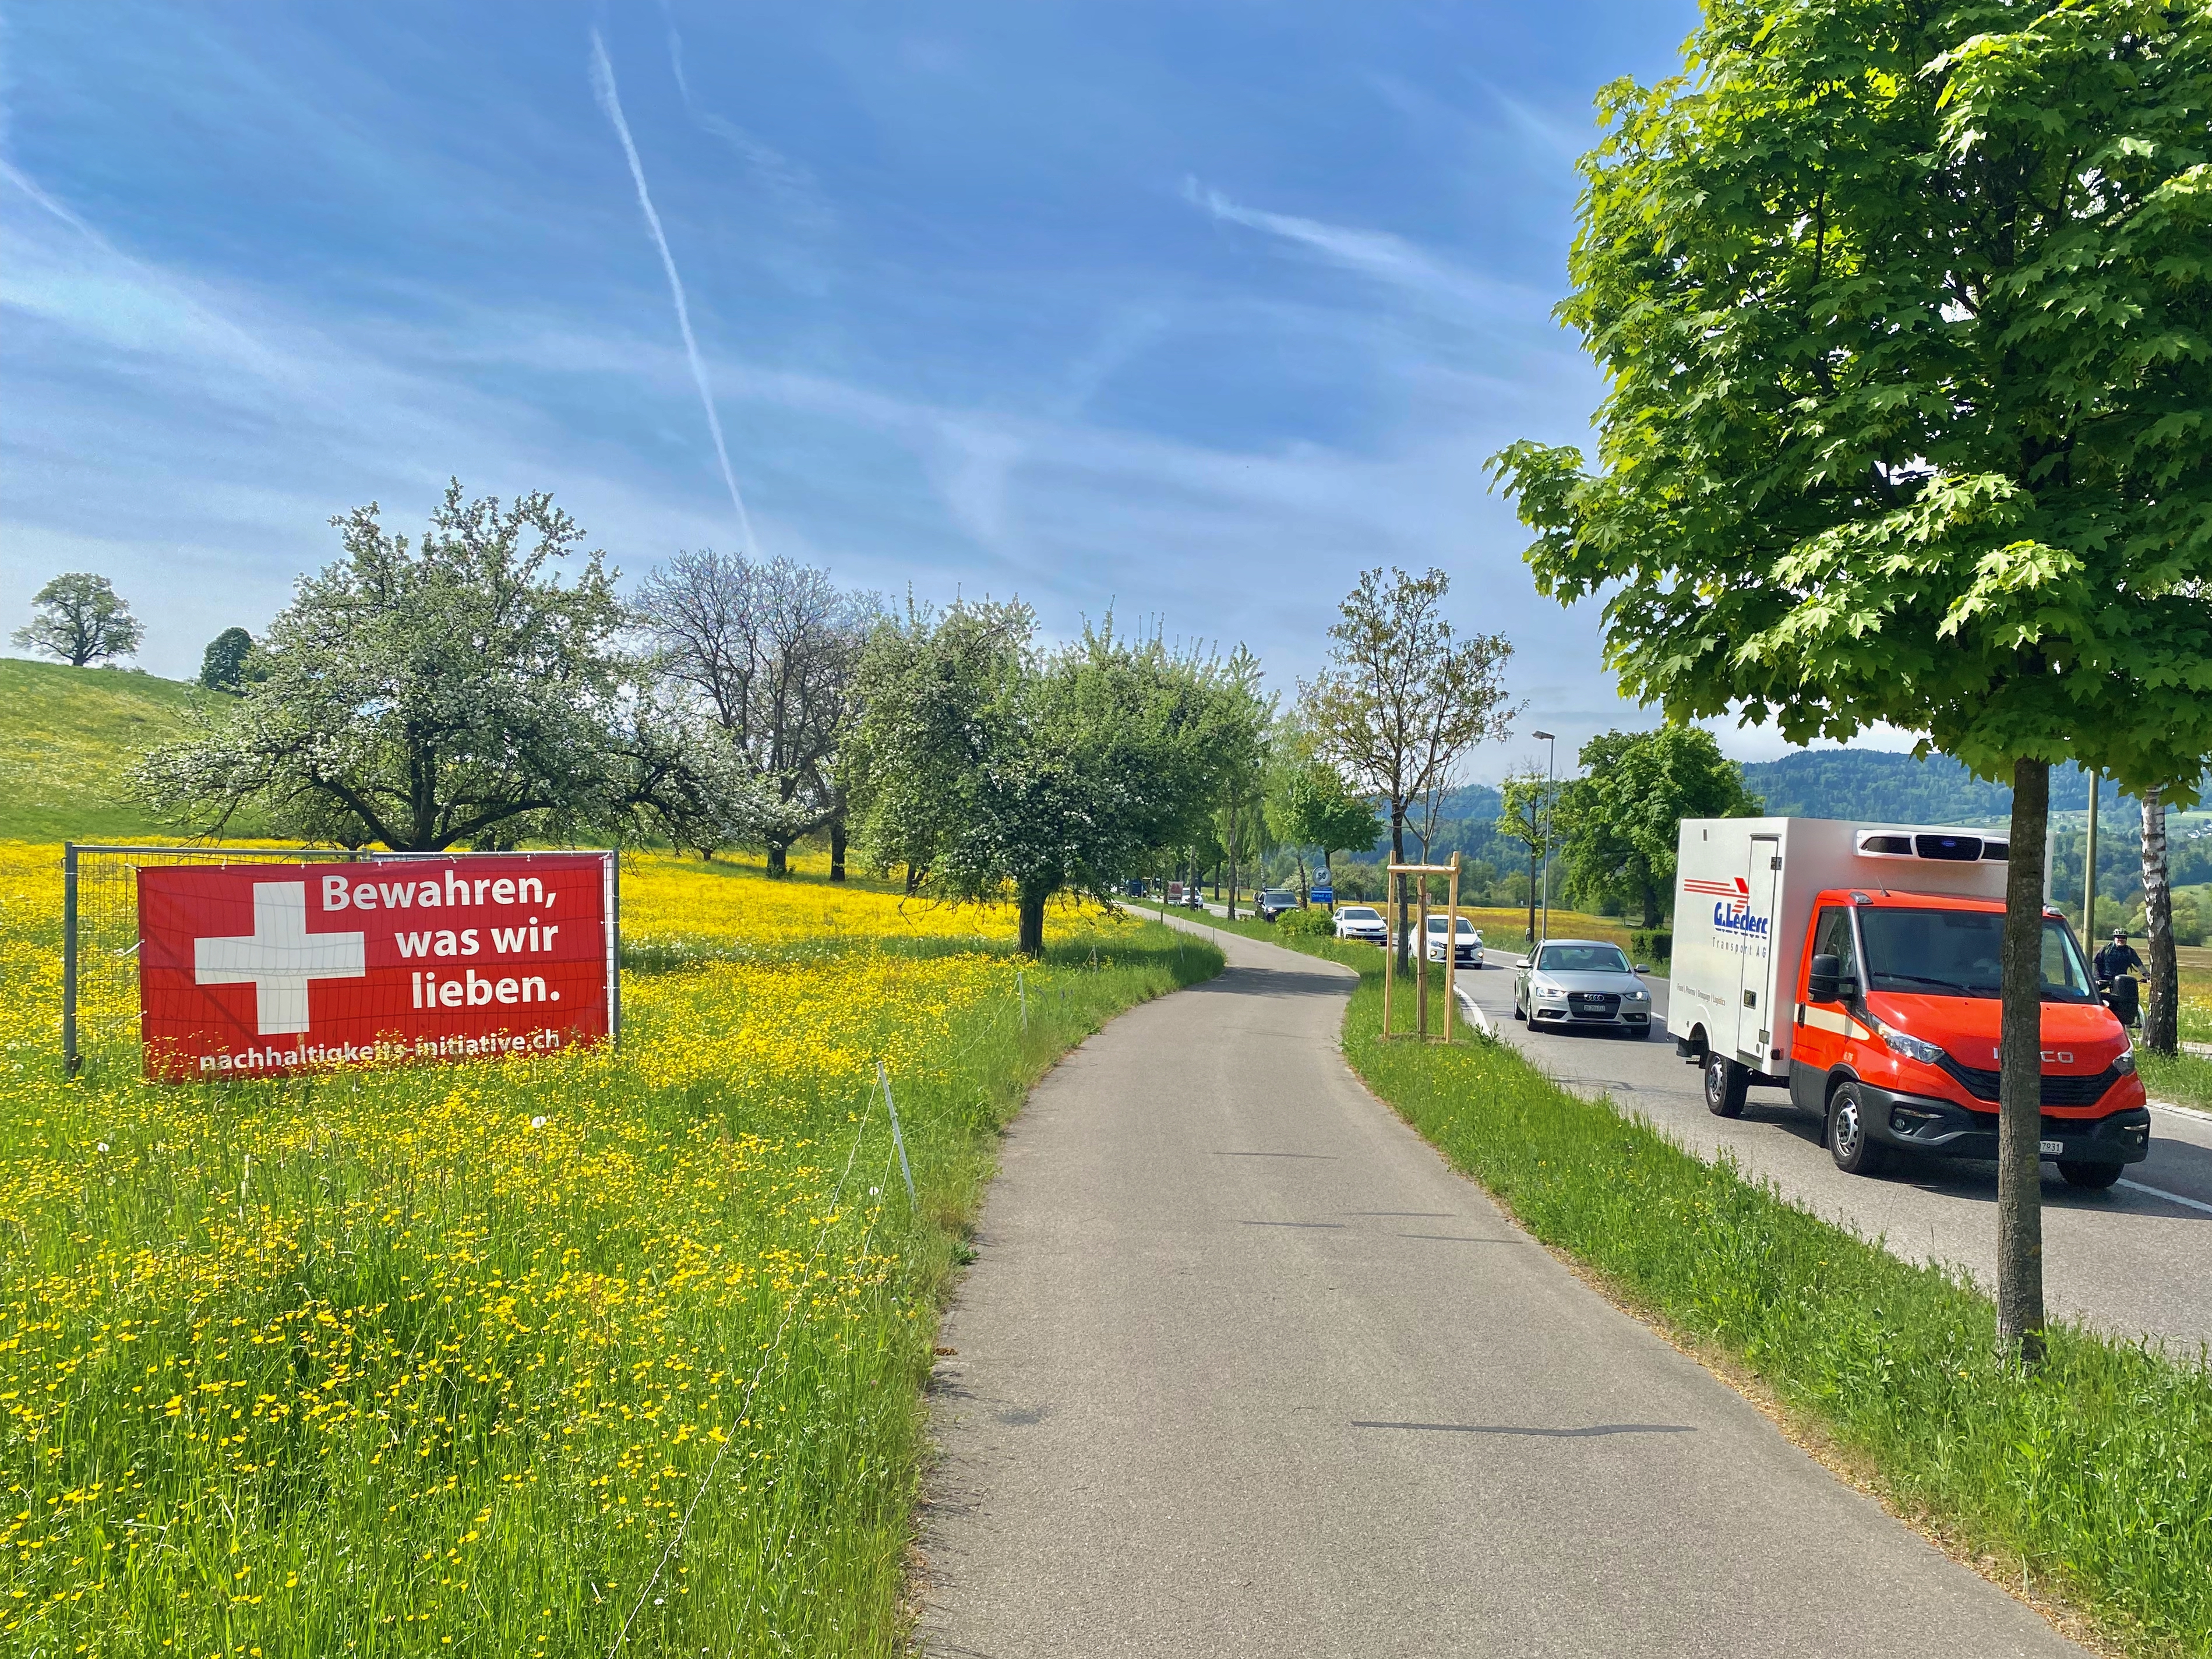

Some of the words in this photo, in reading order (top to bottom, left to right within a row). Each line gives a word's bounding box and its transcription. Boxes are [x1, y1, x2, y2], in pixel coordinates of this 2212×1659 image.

[322, 870, 557, 911] Bewahren,
[1714, 902, 1768, 934] G.Leclerc
[394, 929, 480, 958] was
[490, 916, 559, 954] wir
[1713, 936, 1752, 956] Transport
[1756, 945, 1766, 958] AG
[412, 969, 560, 1009] lieben.
[1994, 1047, 2074, 1064] ICO
[2040, 1142, 2060, 1152] 7931
